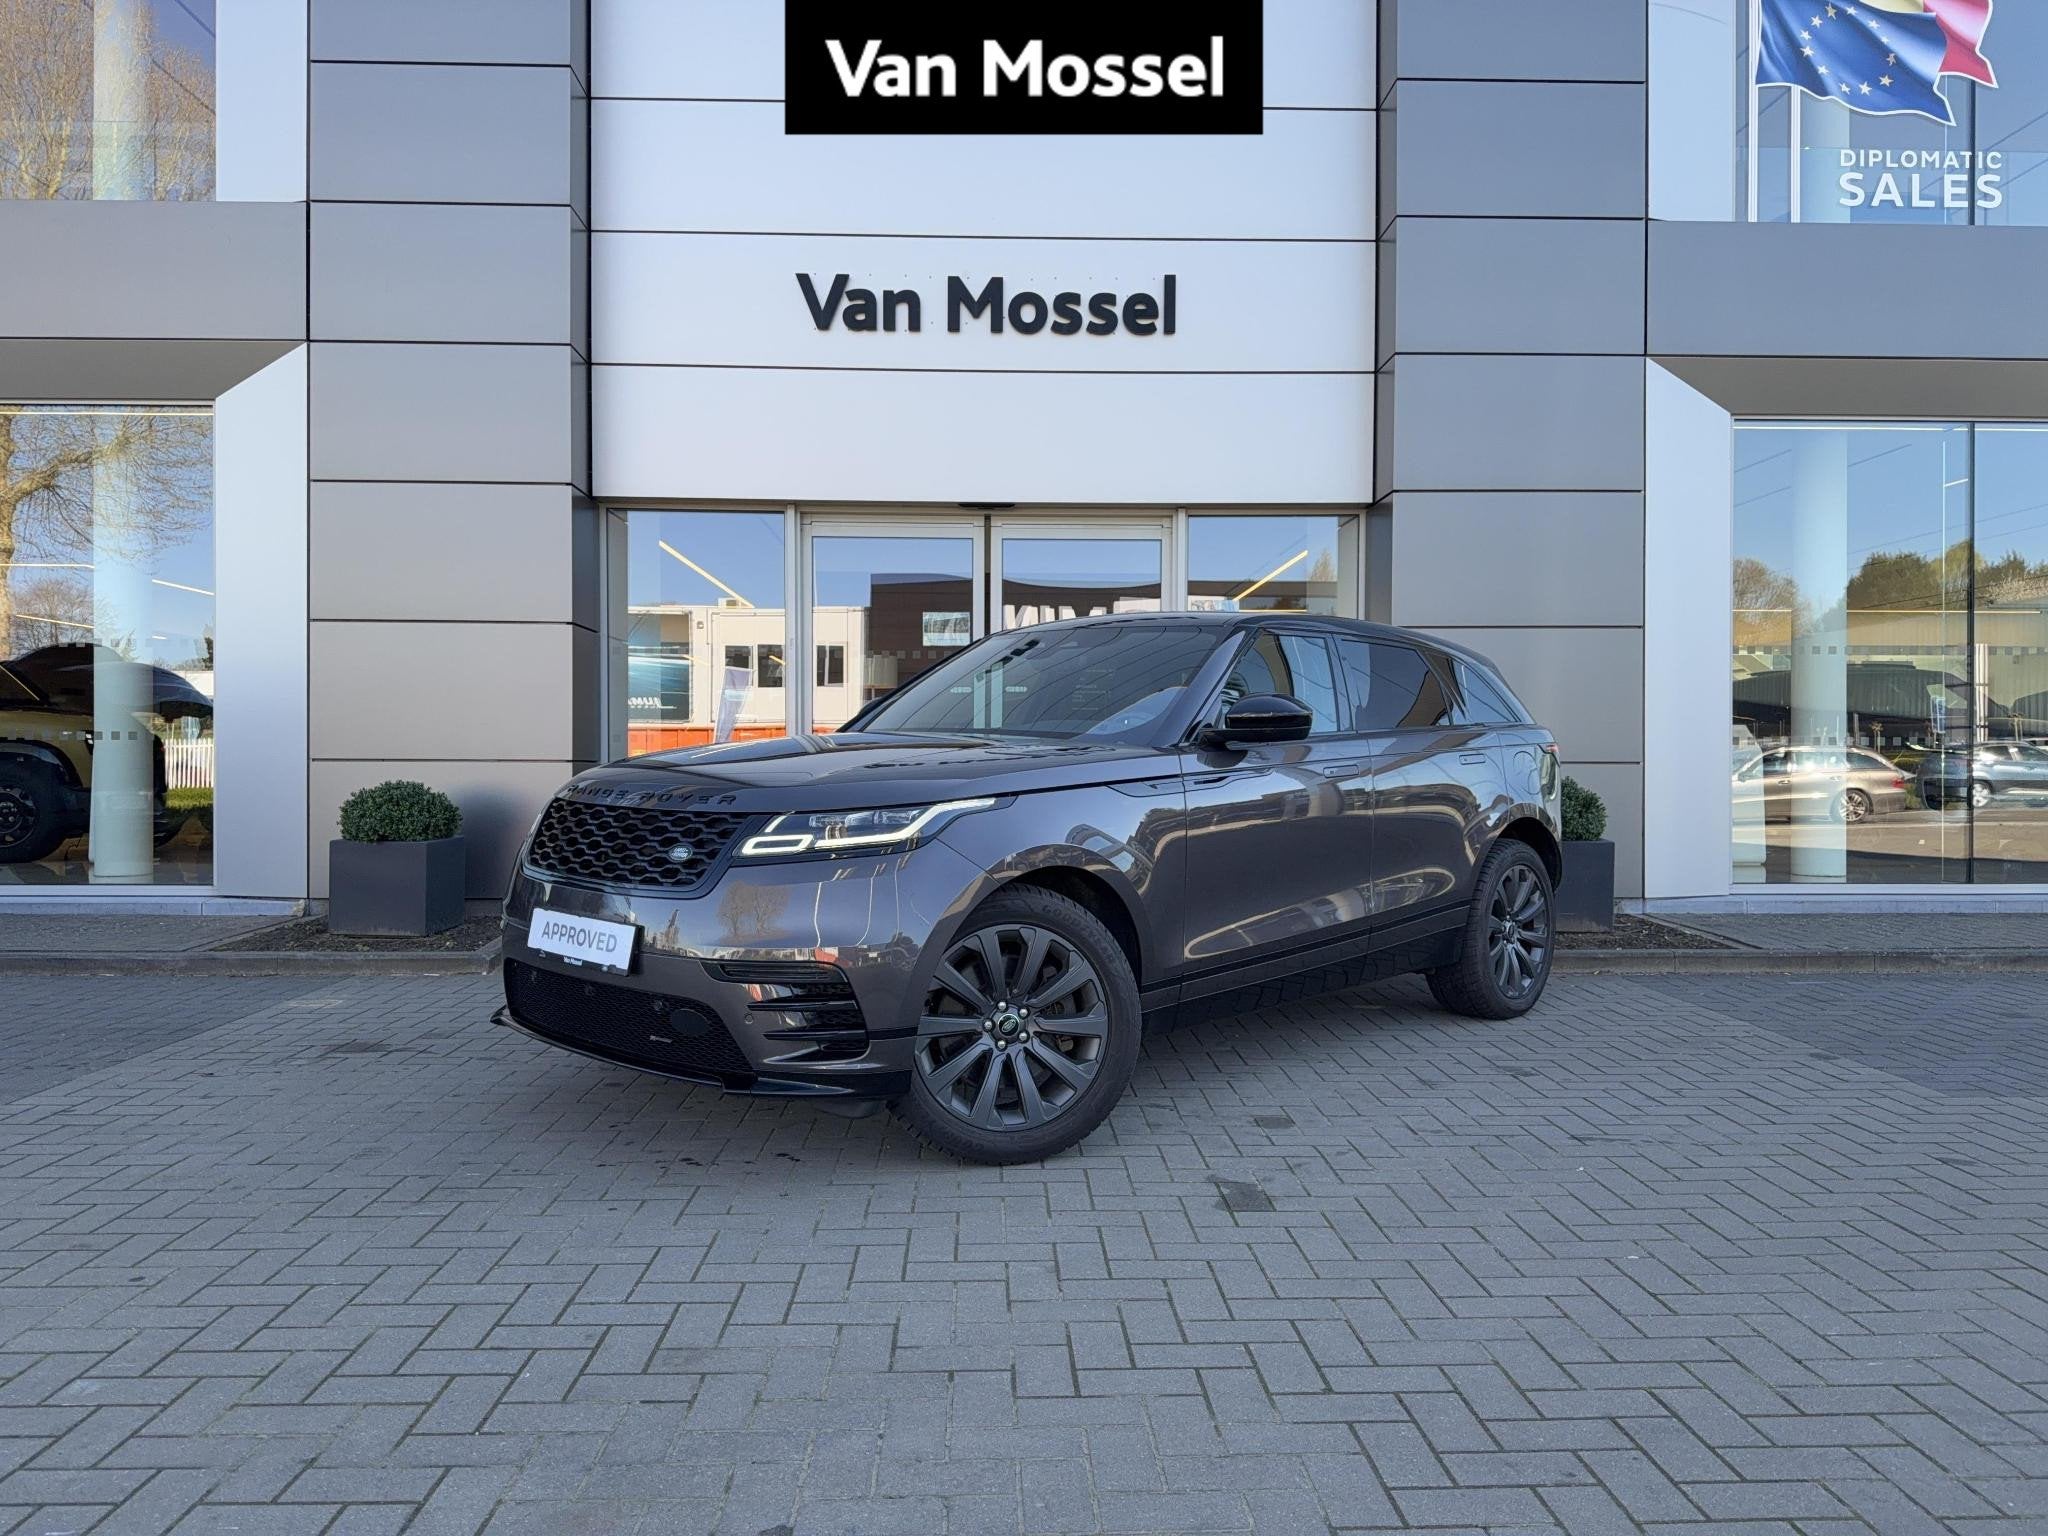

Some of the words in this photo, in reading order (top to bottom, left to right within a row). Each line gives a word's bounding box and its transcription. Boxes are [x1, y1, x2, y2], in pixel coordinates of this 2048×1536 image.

[1840, 149, 2002, 169] DIPLOMATIC
[1839, 172, 2003, 209] SALES
[795, 273, 921, 332] Van
[947, 274, 1177, 336] Mossel
[567, 784, 629, 800] RANGE
[640, 791, 737, 806] ROVER
[541, 921, 618, 953] APPROVED
